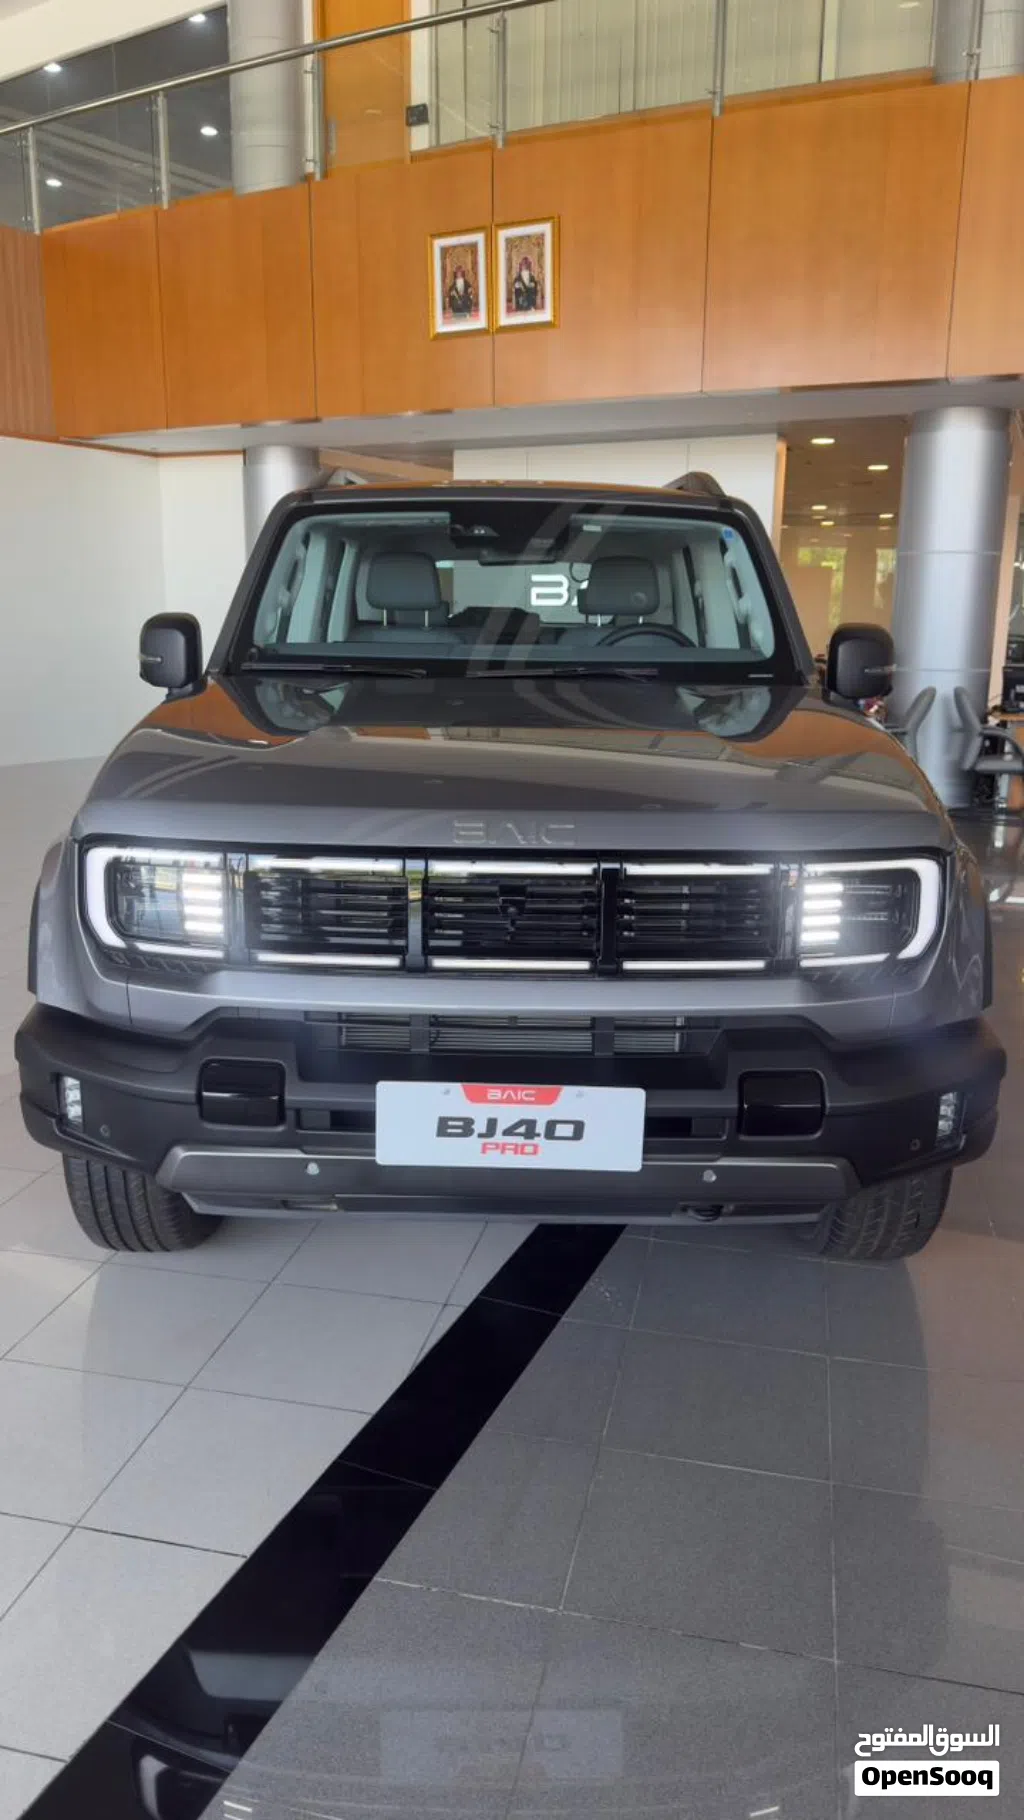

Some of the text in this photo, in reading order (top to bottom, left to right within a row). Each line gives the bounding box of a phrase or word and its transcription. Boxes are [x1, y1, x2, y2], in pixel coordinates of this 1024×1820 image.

[453, 820, 576, 845] BAIC
[486, 1088, 536, 1102] BAIC
[435, 1115, 586, 1142] BJ40
[480, 1142, 541, 1156] PRO
